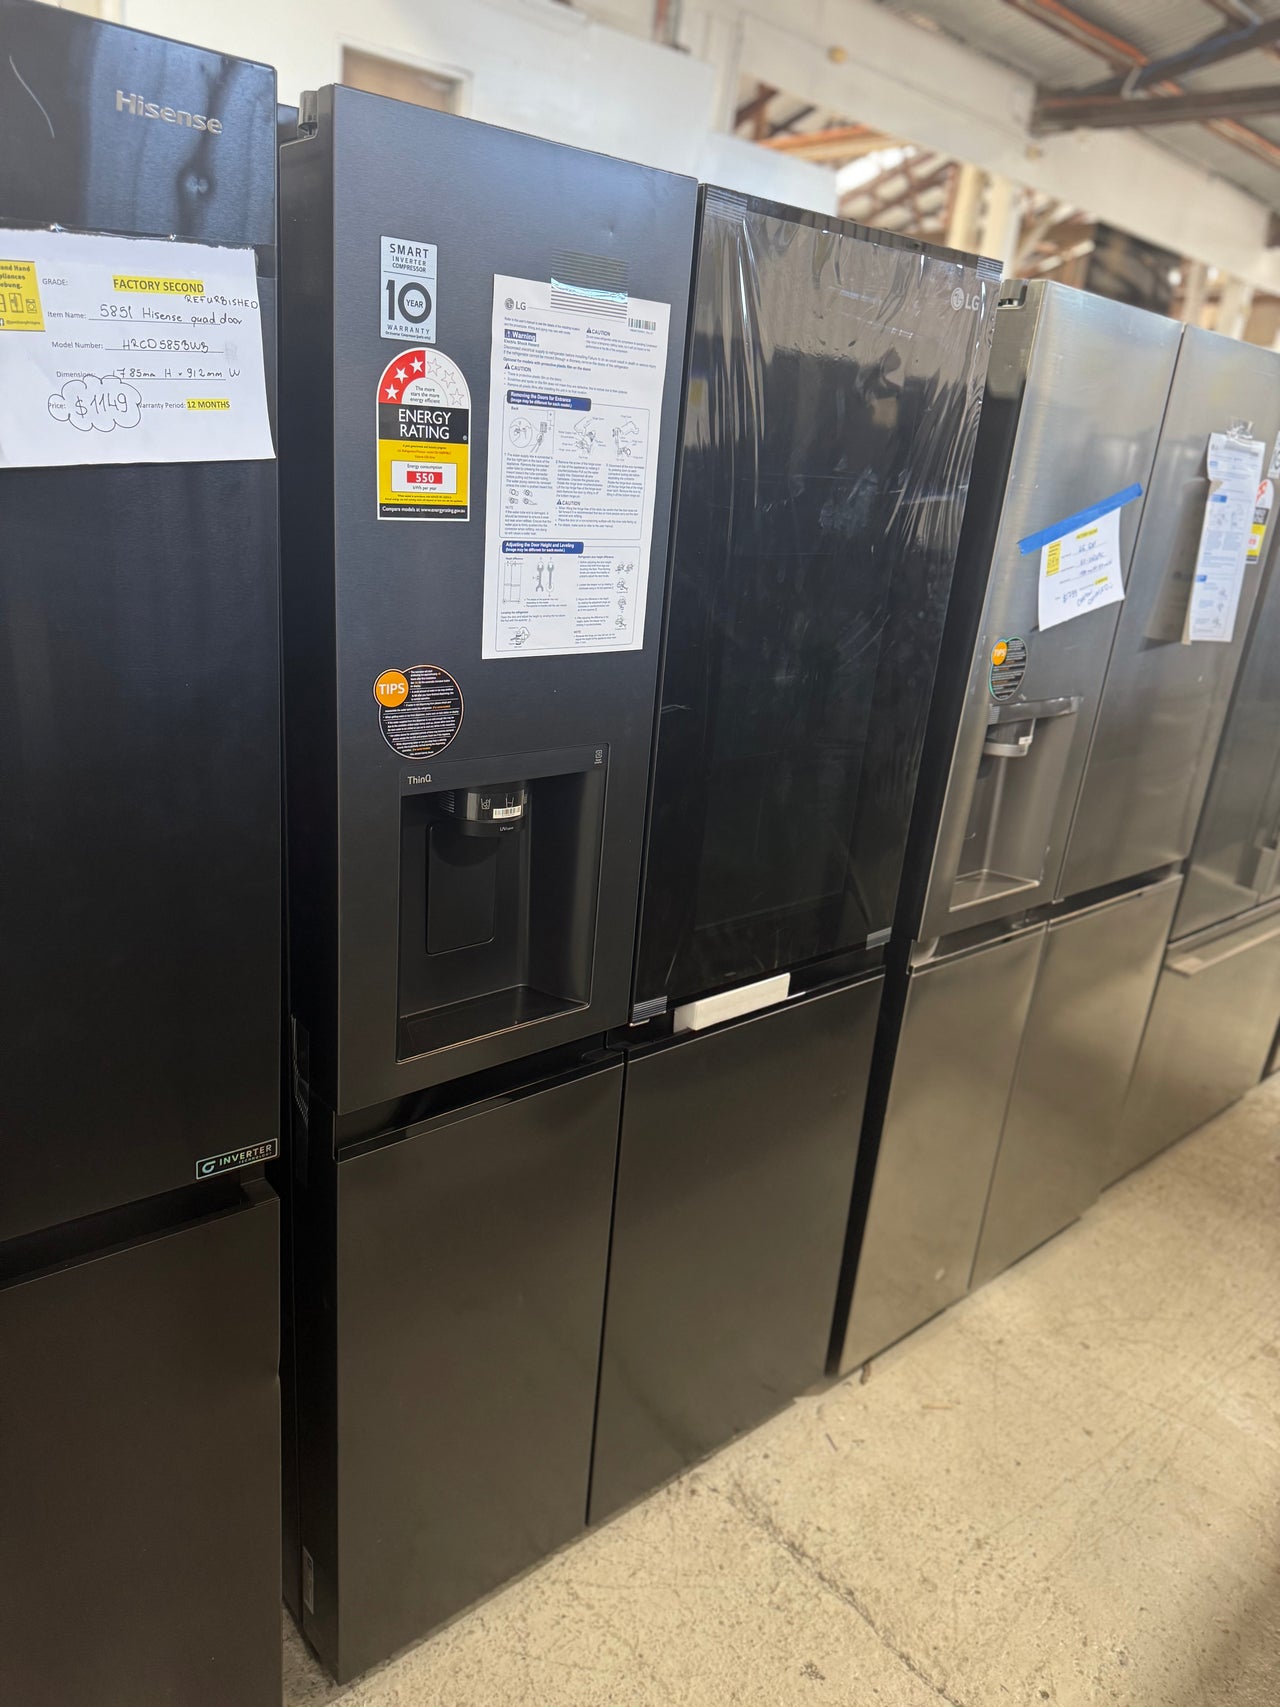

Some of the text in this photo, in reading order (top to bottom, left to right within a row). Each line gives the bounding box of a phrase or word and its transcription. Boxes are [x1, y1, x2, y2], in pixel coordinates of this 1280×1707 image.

[116, 90, 223, 136] Hisense
[389, 243, 429, 259] SMART
[392, 255, 427, 266] INVERTER
[392, 262, 427, 273] COMPRESSOR
[42, 278, 69, 286] GRADE:
[113, 279, 205, 294] FACTORY SECOND
[184, 295, 259, 309] REFURBISHED
[386, 279, 432, 324] 10 YEAR
[515, 300, 526, 310] LG
[965, 293, 980, 311] LG
[142, 307, 183, 324] Hisense
[191, 310, 216, 327] quad
[220, 310, 243, 325] door
[387, 324, 430, 334] WARRANTY
[591, 328, 610, 336] CAUTION
[512, 330, 535, 341] Warning
[51, 341, 73, 349] Model
[74, 341, 103, 350] Number:
[164, 369, 172, 377] H
[187, 369, 224, 378] 912mm
[229, 368, 241, 377] W
[510, 364, 531, 372] CAUTION
[510, 391, 530, 399] Removing
[75, 392, 127, 417] $1149
[187, 400, 197, 409] 12
[197, 400, 231, 410] MONTHS
[398, 408, 452, 425] ENERGY
[400, 424, 450, 440] RATING
[416, 472, 434, 483] 550
[378, 683, 405, 695] TIPS
[407, 774, 432, 785] ThinQ
[219, 1144, 272, 1166] INVERTER
